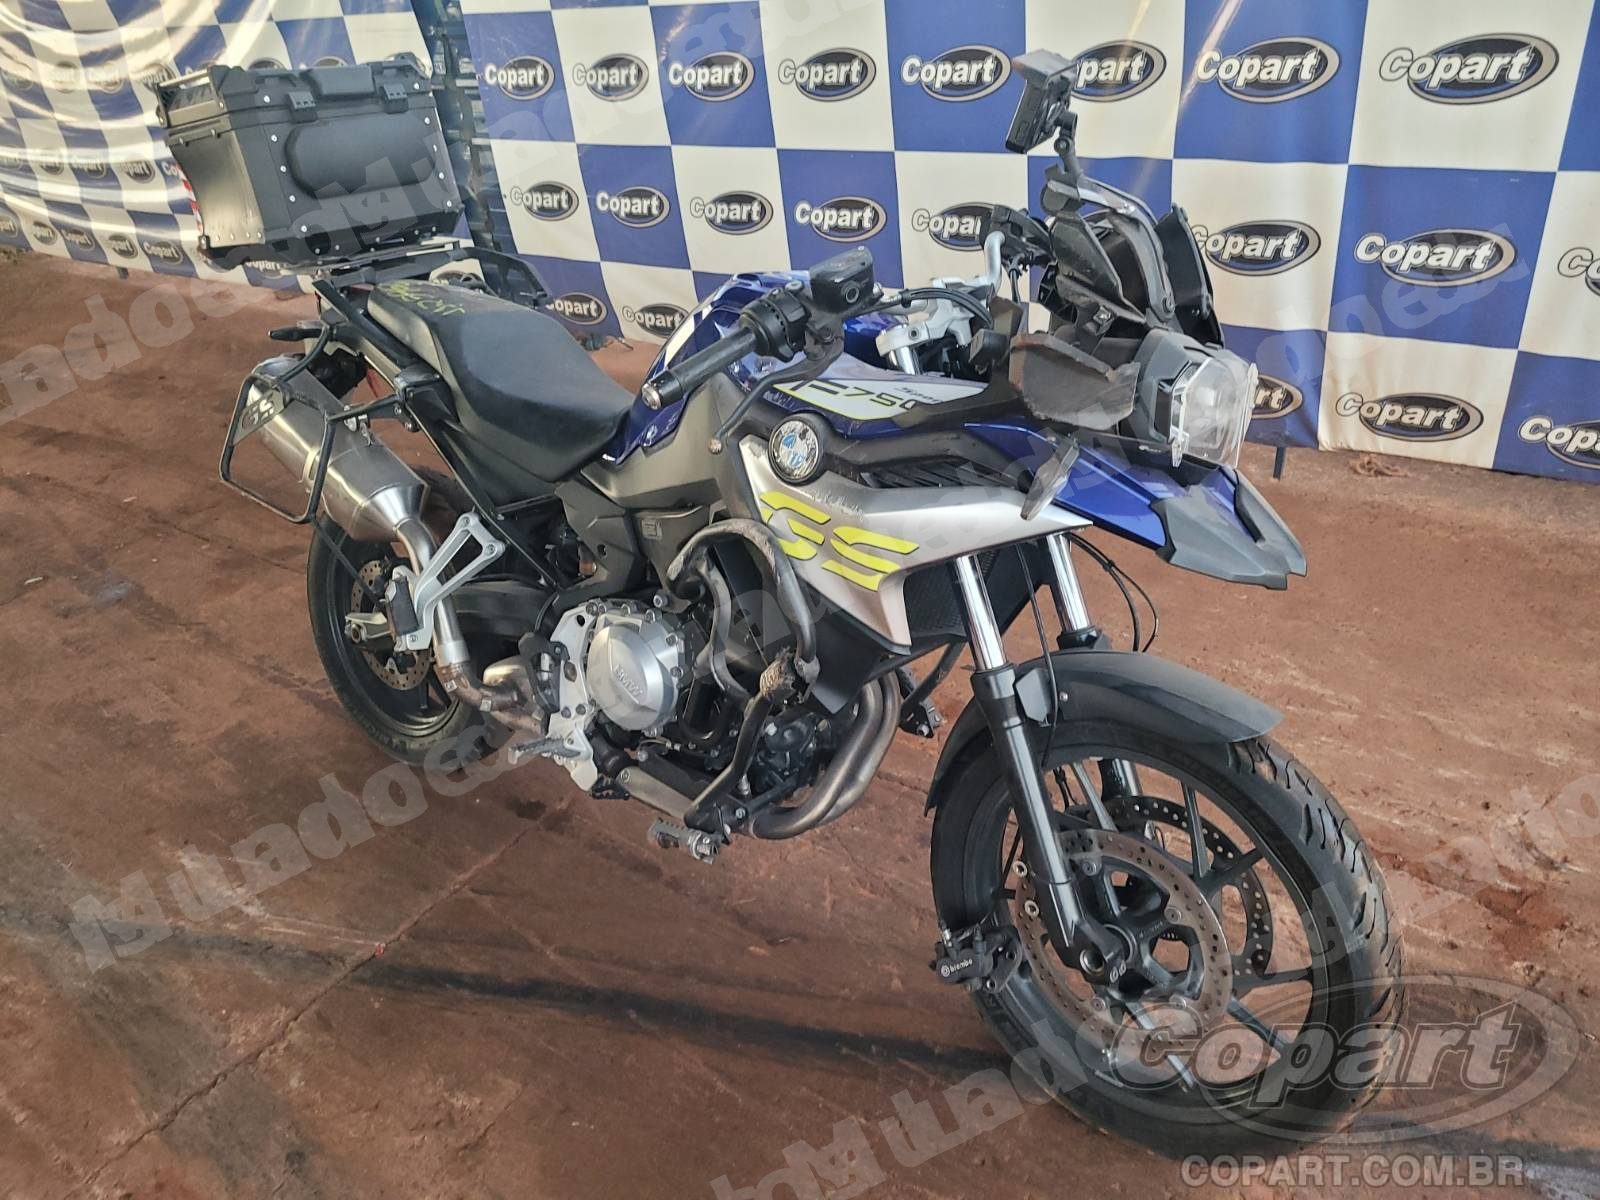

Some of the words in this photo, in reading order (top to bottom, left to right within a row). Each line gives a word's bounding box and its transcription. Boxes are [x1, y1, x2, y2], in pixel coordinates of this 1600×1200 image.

[485, 64, 545, 87] Copart
[572, 62, 638, 90] Copart
[668, 62, 742, 89] Copart
[779, 57, 862, 92] Copart
[902, 53, 998, 89] Copart
[1075, 52, 1146, 89] part
[1197, 47, 1322, 86] Copart
[1379, 42, 1537, 91] Copart
[511, 186, 570, 214] Copart
[596, 191, 660, 219] Copart
[690, 196, 762, 224] Copart
[795, 200, 875, 233] Copart
[1355, 232, 1499, 273] Copart
[621, 305, 681, 328] Copart
[1336, 392, 1474, 432] Copart
[1518, 415, 1600, 456] Cop
[950, 958, 973, 973] brembo
